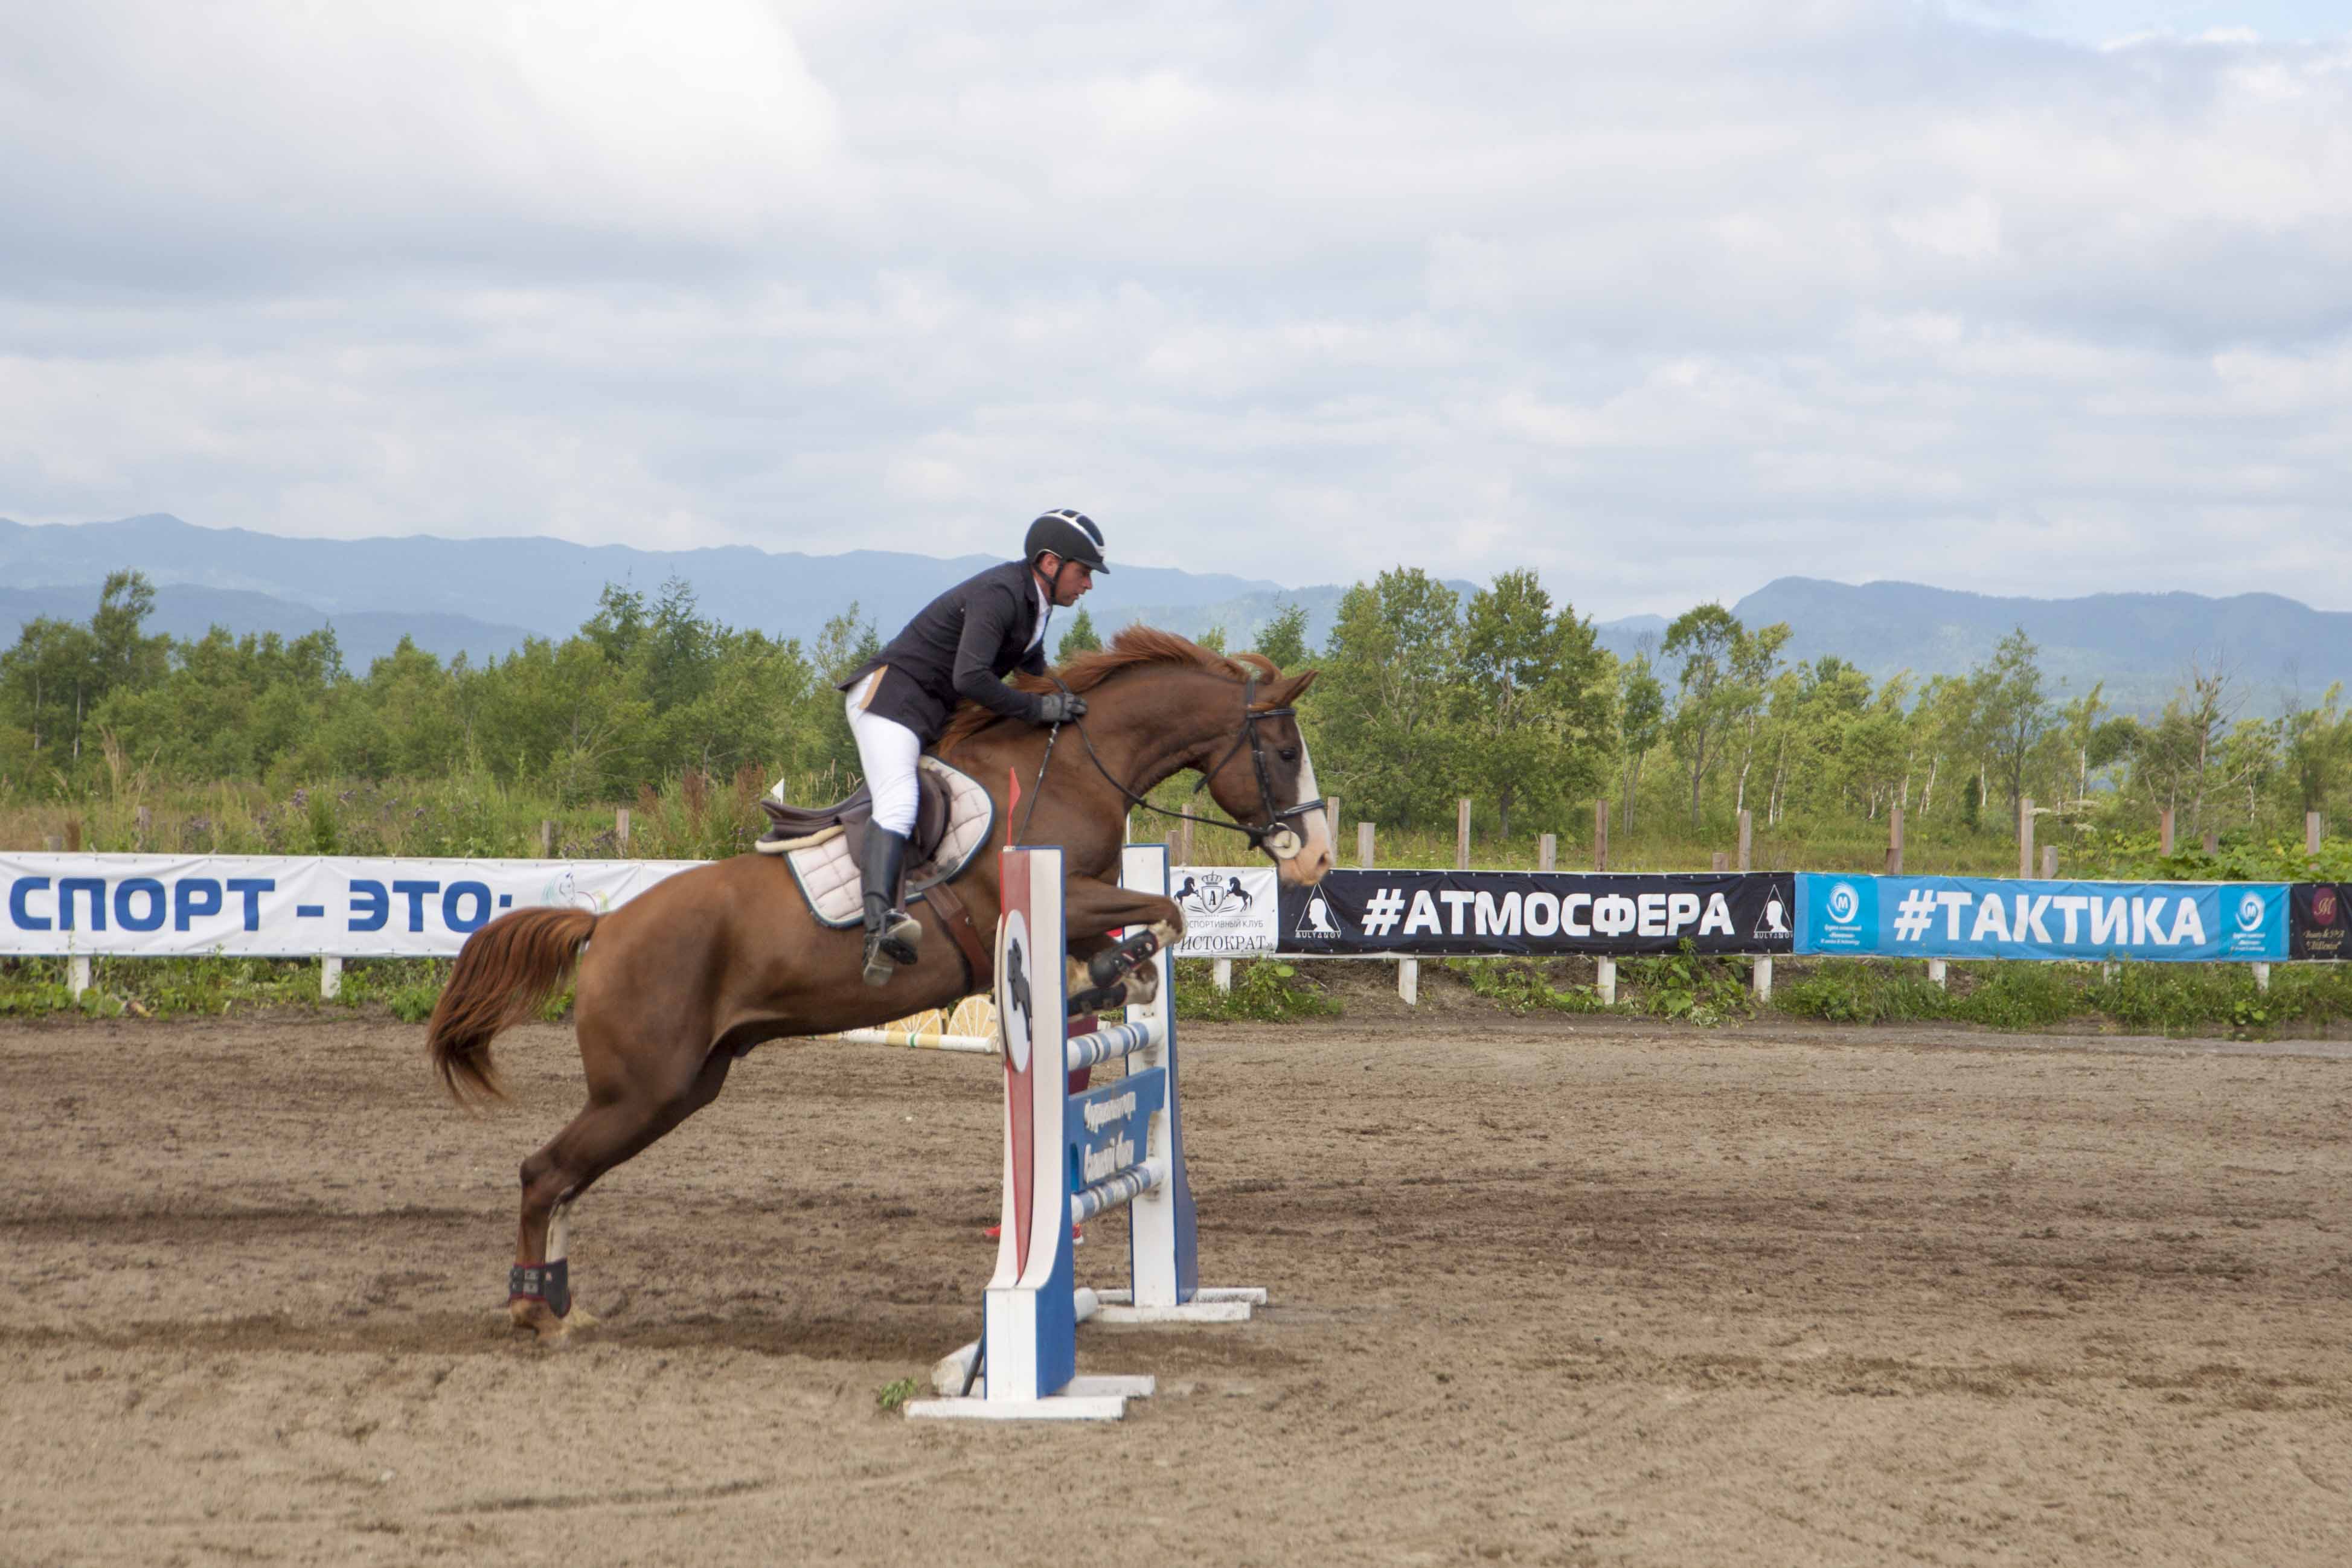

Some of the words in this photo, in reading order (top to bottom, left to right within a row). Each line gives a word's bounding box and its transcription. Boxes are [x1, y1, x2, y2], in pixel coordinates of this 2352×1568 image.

[10, 877, 275, 932] СПОРТ
[1243, 920, 1263, 928] КЛУБ
[1360, 888, 1735, 937] #АТМОСФЕРА
[1894, 889, 2206, 946] #ТАКТИКА
[1179, 936, 1273, 950] ИСТОКРАТ»
